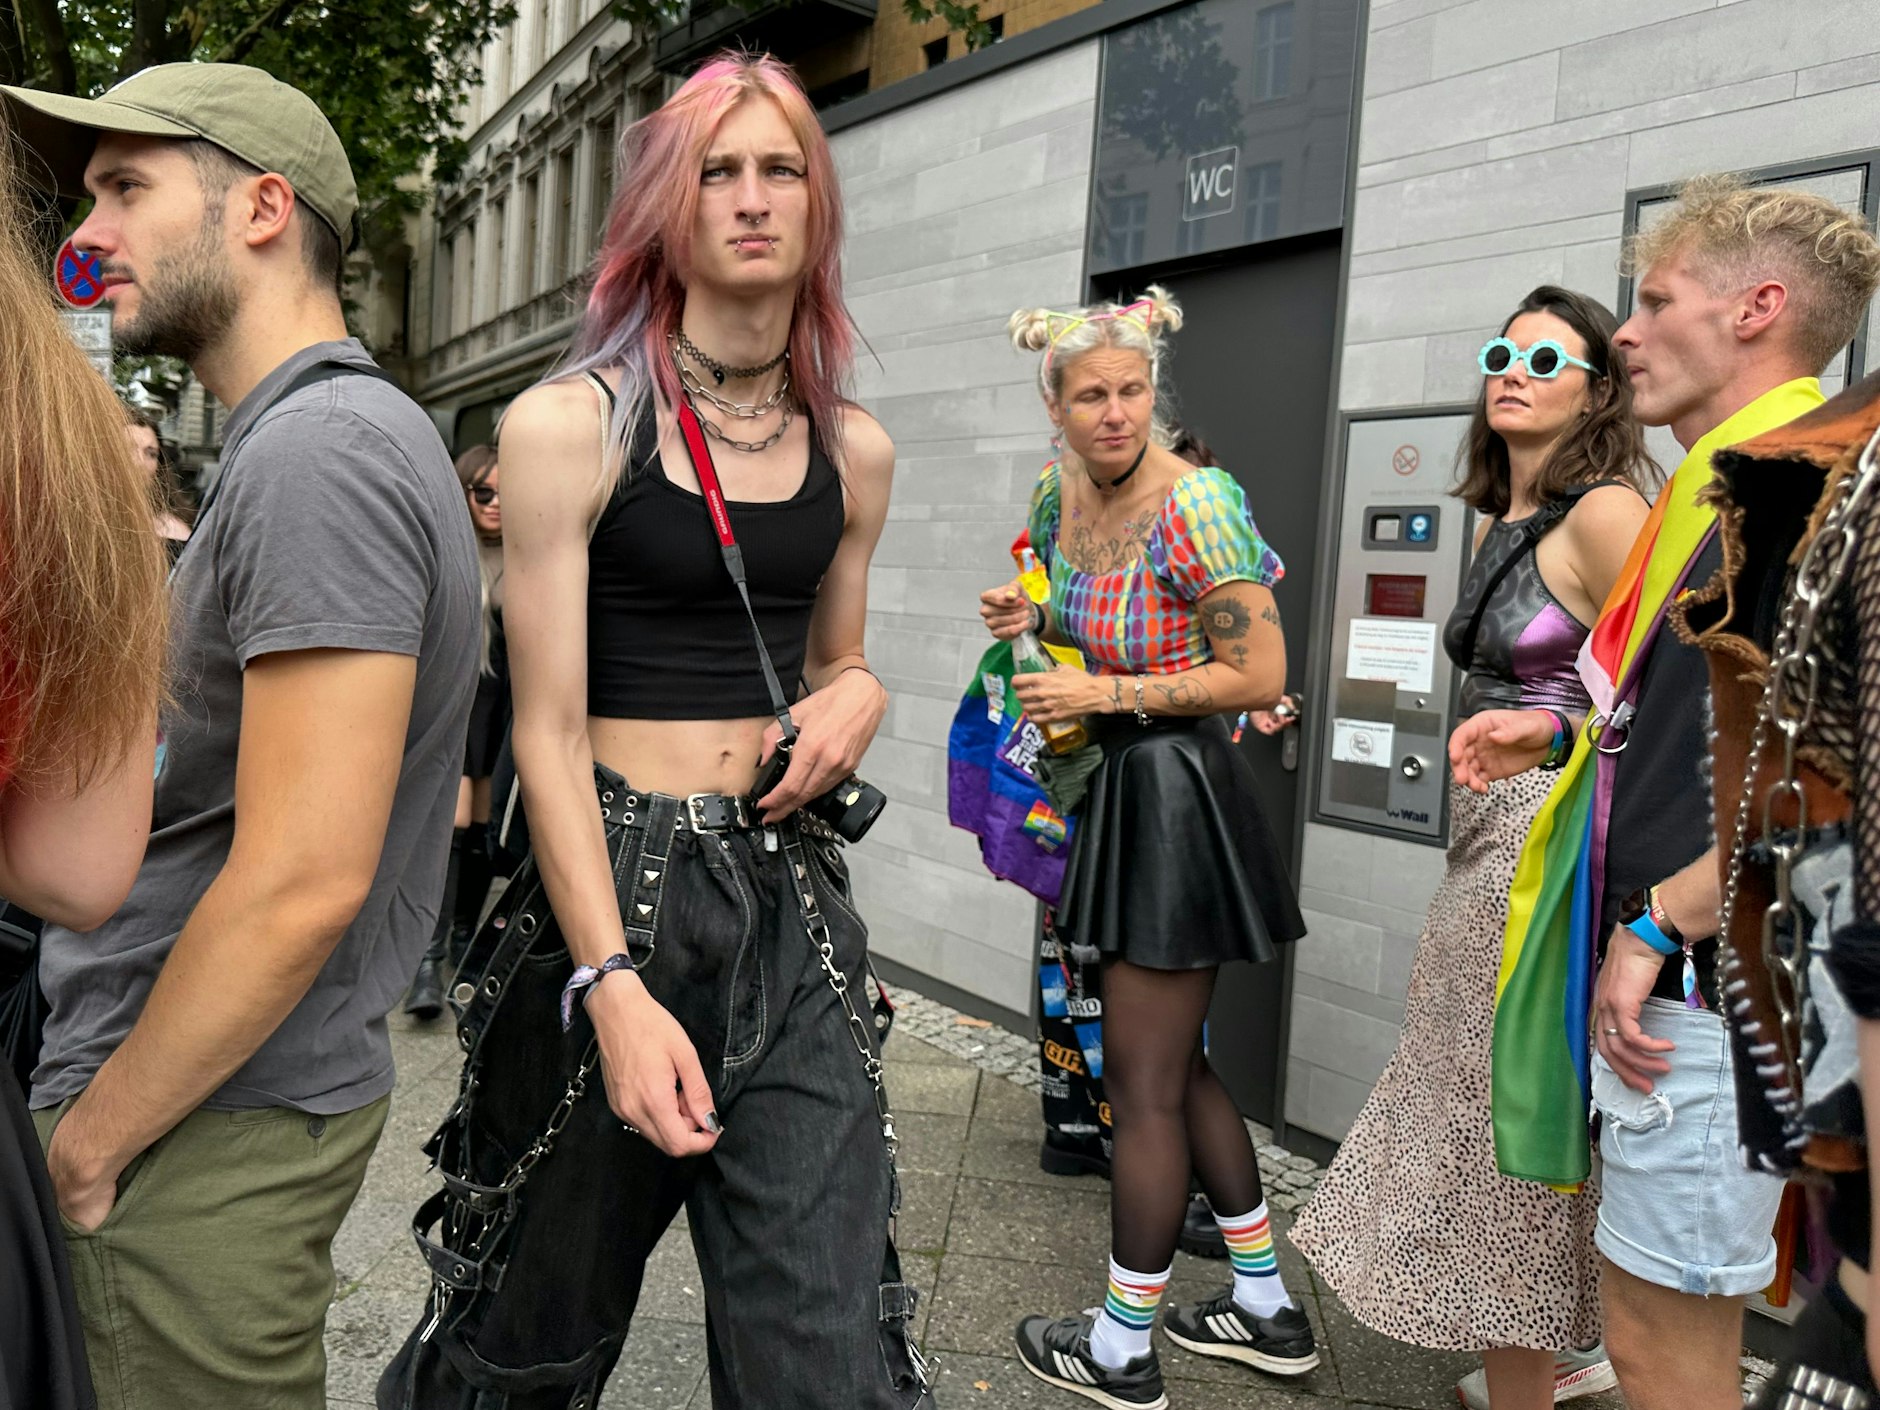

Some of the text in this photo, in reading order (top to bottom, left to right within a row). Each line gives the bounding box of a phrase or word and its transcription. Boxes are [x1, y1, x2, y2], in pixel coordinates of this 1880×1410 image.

[1190, 163, 1233, 204] WC
[708, 489, 728, 535] GRUNDIG
[1400, 809, 1429, 824] Wall
